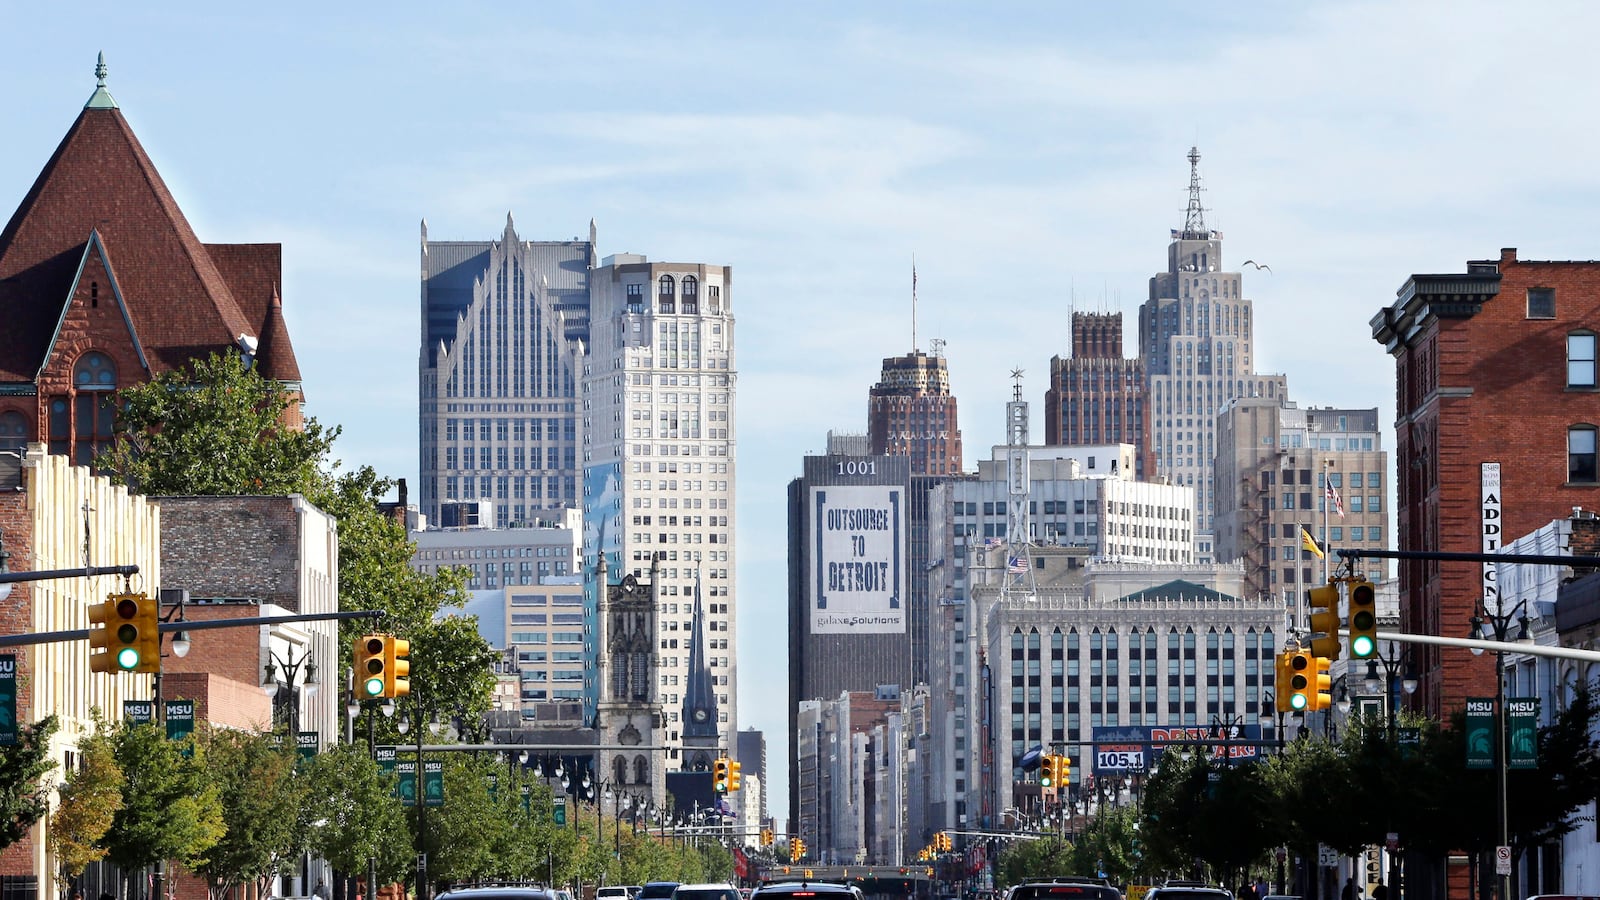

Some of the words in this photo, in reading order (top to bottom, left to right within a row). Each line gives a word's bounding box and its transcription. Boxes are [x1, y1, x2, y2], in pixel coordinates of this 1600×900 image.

[837, 461, 876, 475] 1001
[827, 508, 889, 531] OUTSOURCE
[851, 535, 865, 557] TO
[1484, 493, 1500, 597] ADDION
[828, 561, 888, 592] DETROIT
[124, 705, 150, 715] MSU
[166, 705, 192, 715] MSU
[1467, 702, 1492, 711] MSU
[1509, 702, 1534, 711] MSU
[1100, 753, 1142, 767] 105.1
